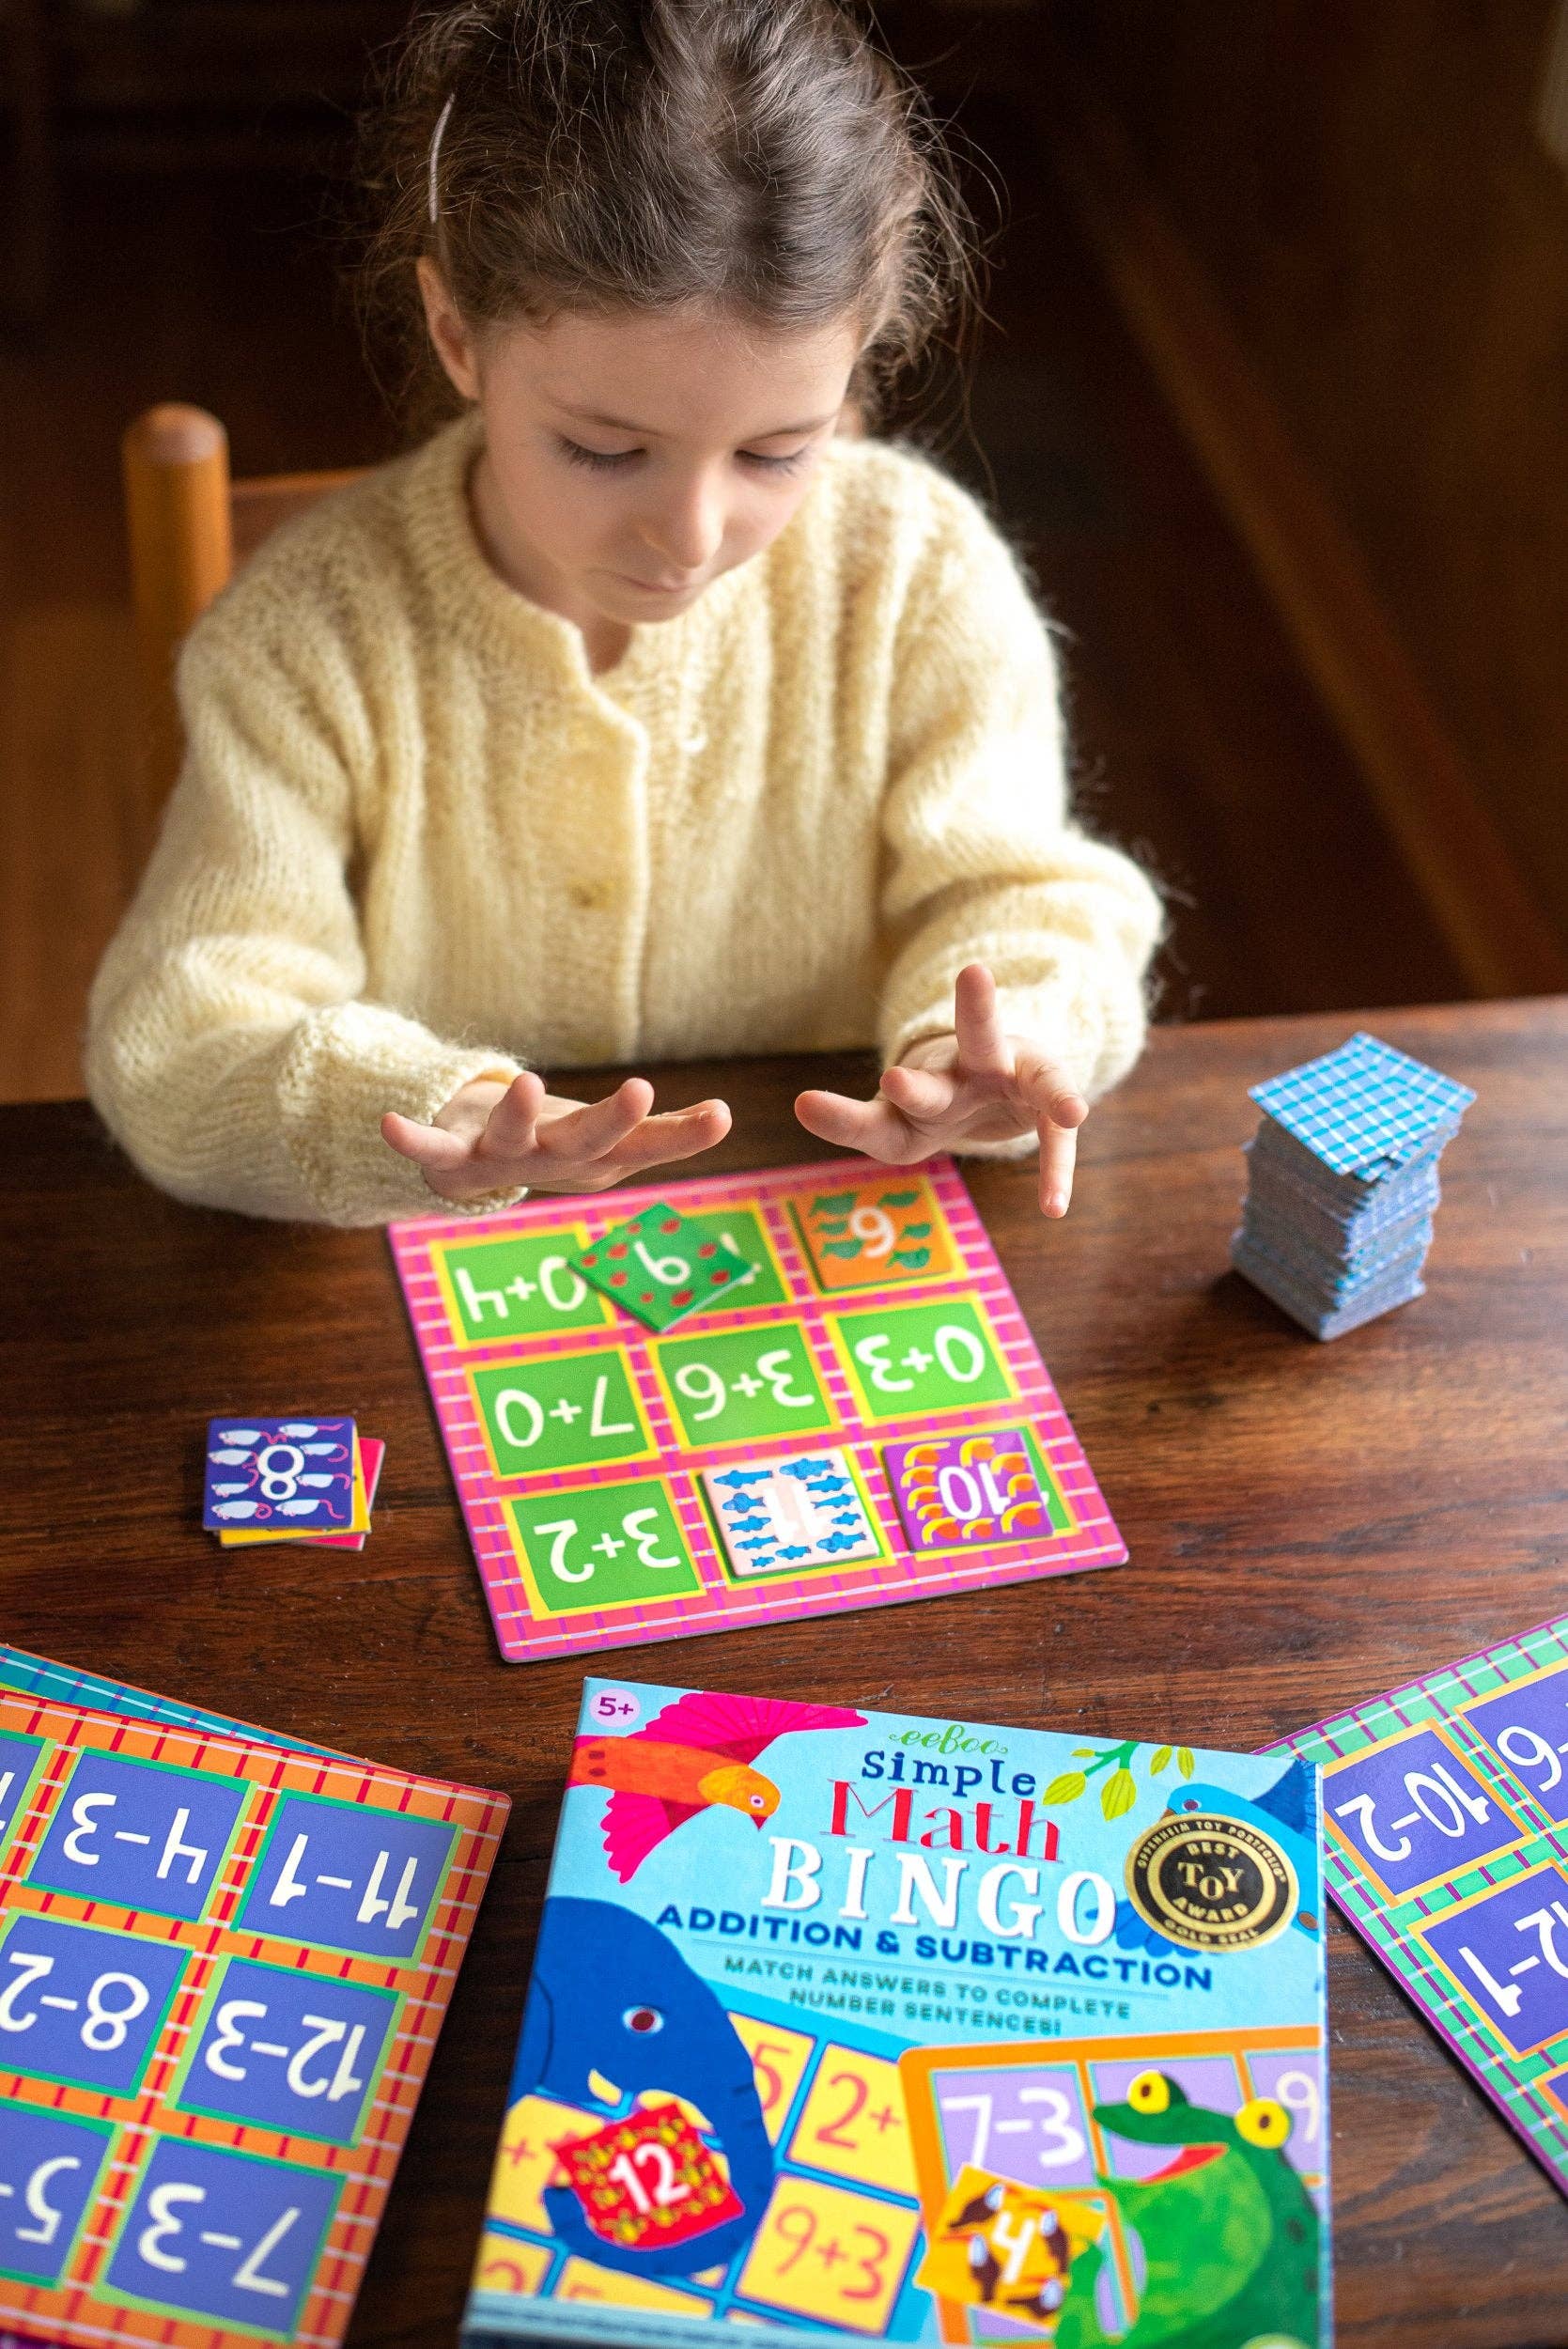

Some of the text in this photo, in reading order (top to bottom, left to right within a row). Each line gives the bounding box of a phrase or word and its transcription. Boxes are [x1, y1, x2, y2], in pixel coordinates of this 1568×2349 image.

[674, 1349, 815, 1422] 3+6
[855, 1324, 986, 1394] 0+3
[494, 1374, 635, 1448] 7+0
[257, 1444, 305, 1501] 8
[939, 1461, 1012, 1520] 10
[534, 1506, 682, 1583] 3+2
[762, 1481, 827, 1542] 11
[598, 1696, 635, 1717] 5+
[63, 1792, 209, 1885] 4-3
[819, 1778, 1064, 1864] Math
[1335, 1762, 1491, 1862] 10-2
[269, 1833, 419, 1930] 11-1
[1176, 1860, 1246, 1902] TOY
[1186, 1840, 1240, 1859] BEST
[761, 1835, 1117, 1945] BINGO
[1172, 1896, 1250, 1923] AWARD
[656, 1904, 1212, 1991] ADDITION & SUBTRACTION
[0, 1952, 149, 2051] 8-2
[724, 1954, 1132, 2020] MATCH ANSWERS TO COMPLETE
[789, 1987, 896, 2017] NUMBER
[205, 1999, 366, 2102] 12-3
[940, 2086, 1087, 2169] 7-3
[609, 2141, 692, 2215] 12
[138, 2182, 301, 2297] 7-3
[774, 2204, 891, 2302] 9+3
[991, 2210, 1037, 2284] 4
